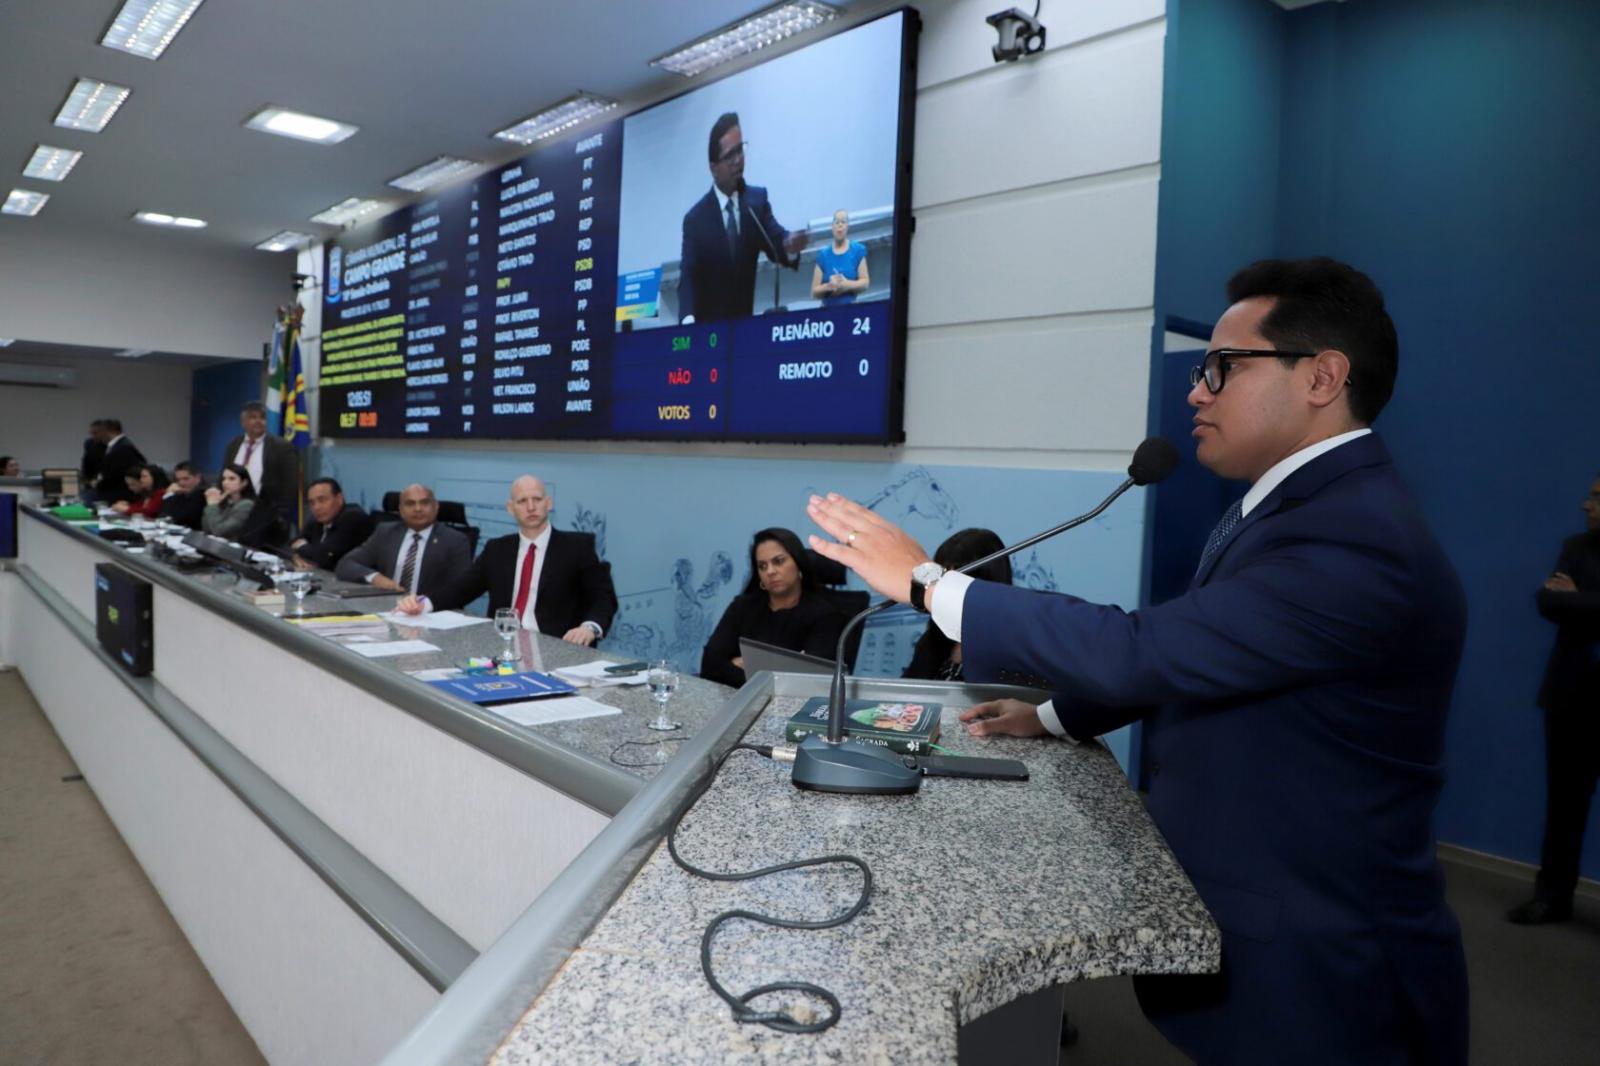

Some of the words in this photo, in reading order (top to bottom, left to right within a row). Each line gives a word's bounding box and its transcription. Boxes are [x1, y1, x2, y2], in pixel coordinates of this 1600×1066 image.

[583, 157, 594, 171] PT
[577, 319, 586, 331] PL
[772, 319, 834, 342] PLENÁRIO
[852, 317, 871, 335] 24
[571, 339, 590, 352] PODE
[672, 337, 691, 351] SIM
[709, 333, 717, 348] 0
[571, 359, 589, 372] PSDB
[779, 361, 833, 380] REMOTO
[859, 359, 869, 376] 0
[669, 367, 691, 385] NÃO
[710, 369, 718, 383] 0
[567, 377, 590, 392] UNIÃO
[565, 399, 592, 412] AVANTE
[658, 405, 690, 420] VOTOS
[709, 404, 717, 420] 0
